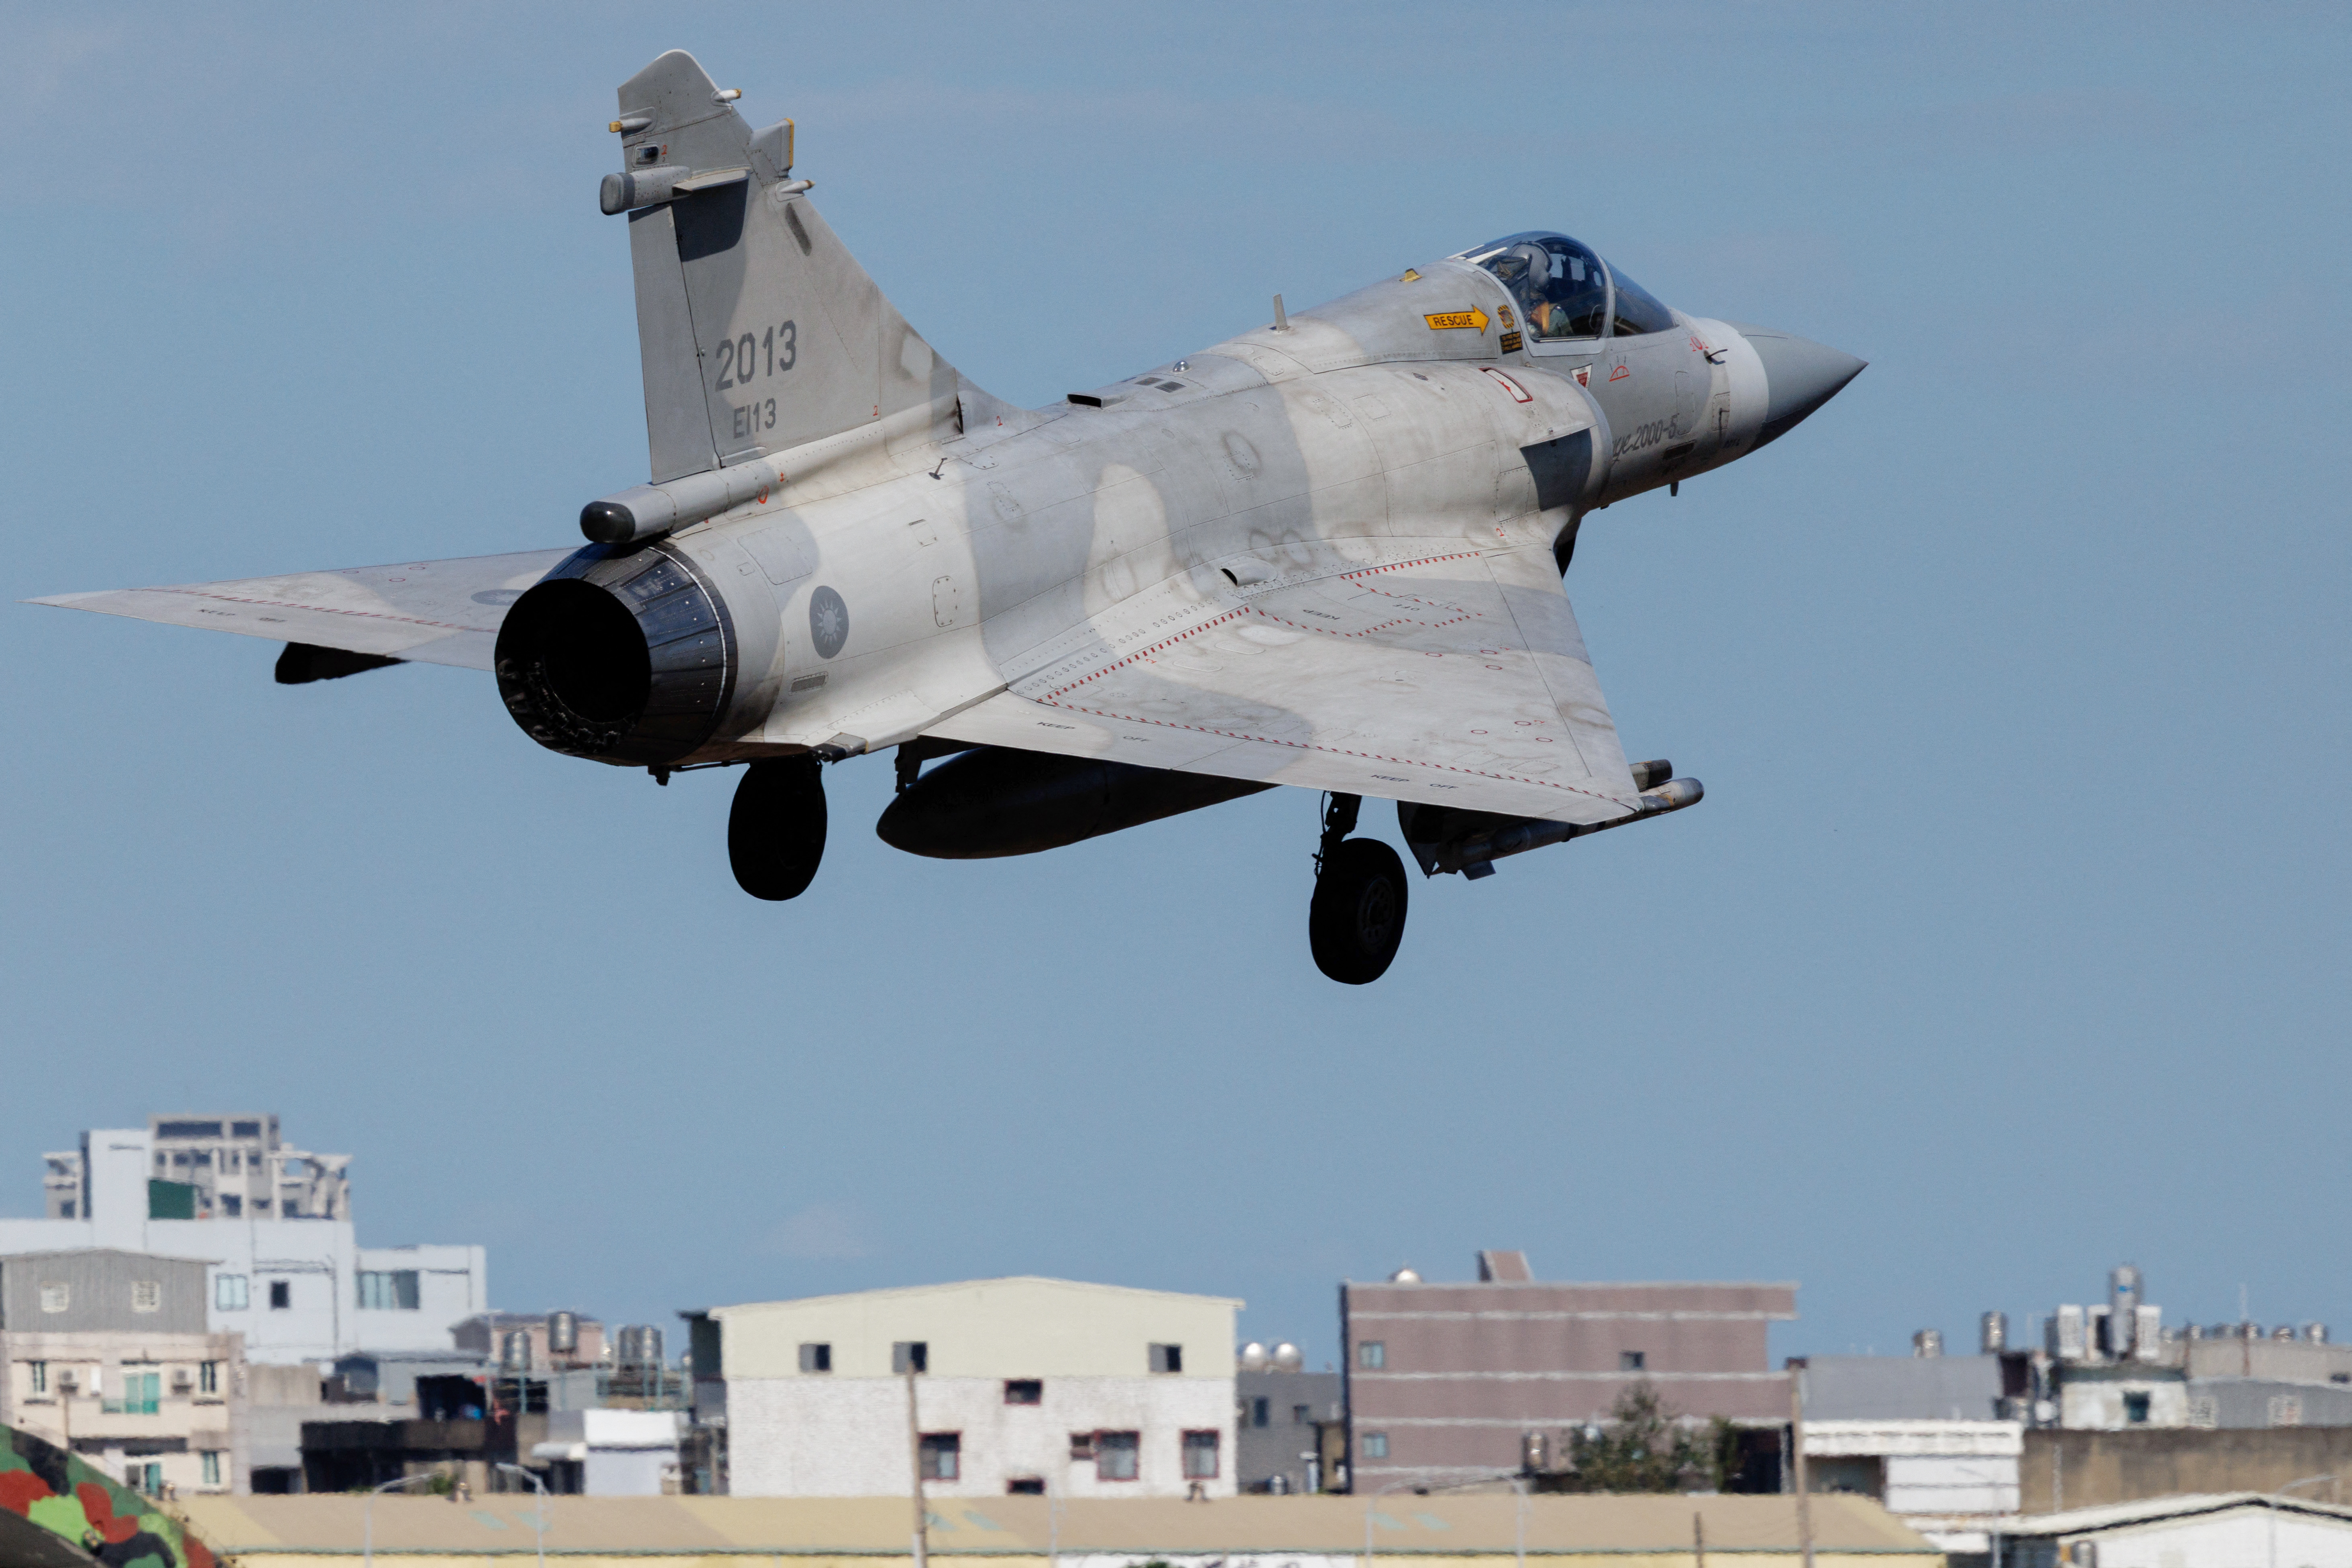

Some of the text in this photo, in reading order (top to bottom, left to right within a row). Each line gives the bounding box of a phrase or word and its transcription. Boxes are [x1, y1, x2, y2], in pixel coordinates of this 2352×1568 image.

[1433, 315, 1473, 326] RESCUE
[715, 320, 796, 392] 2013
[733, 397, 776, 439] EI13
[1303, 609, 1341, 620] KEEP
